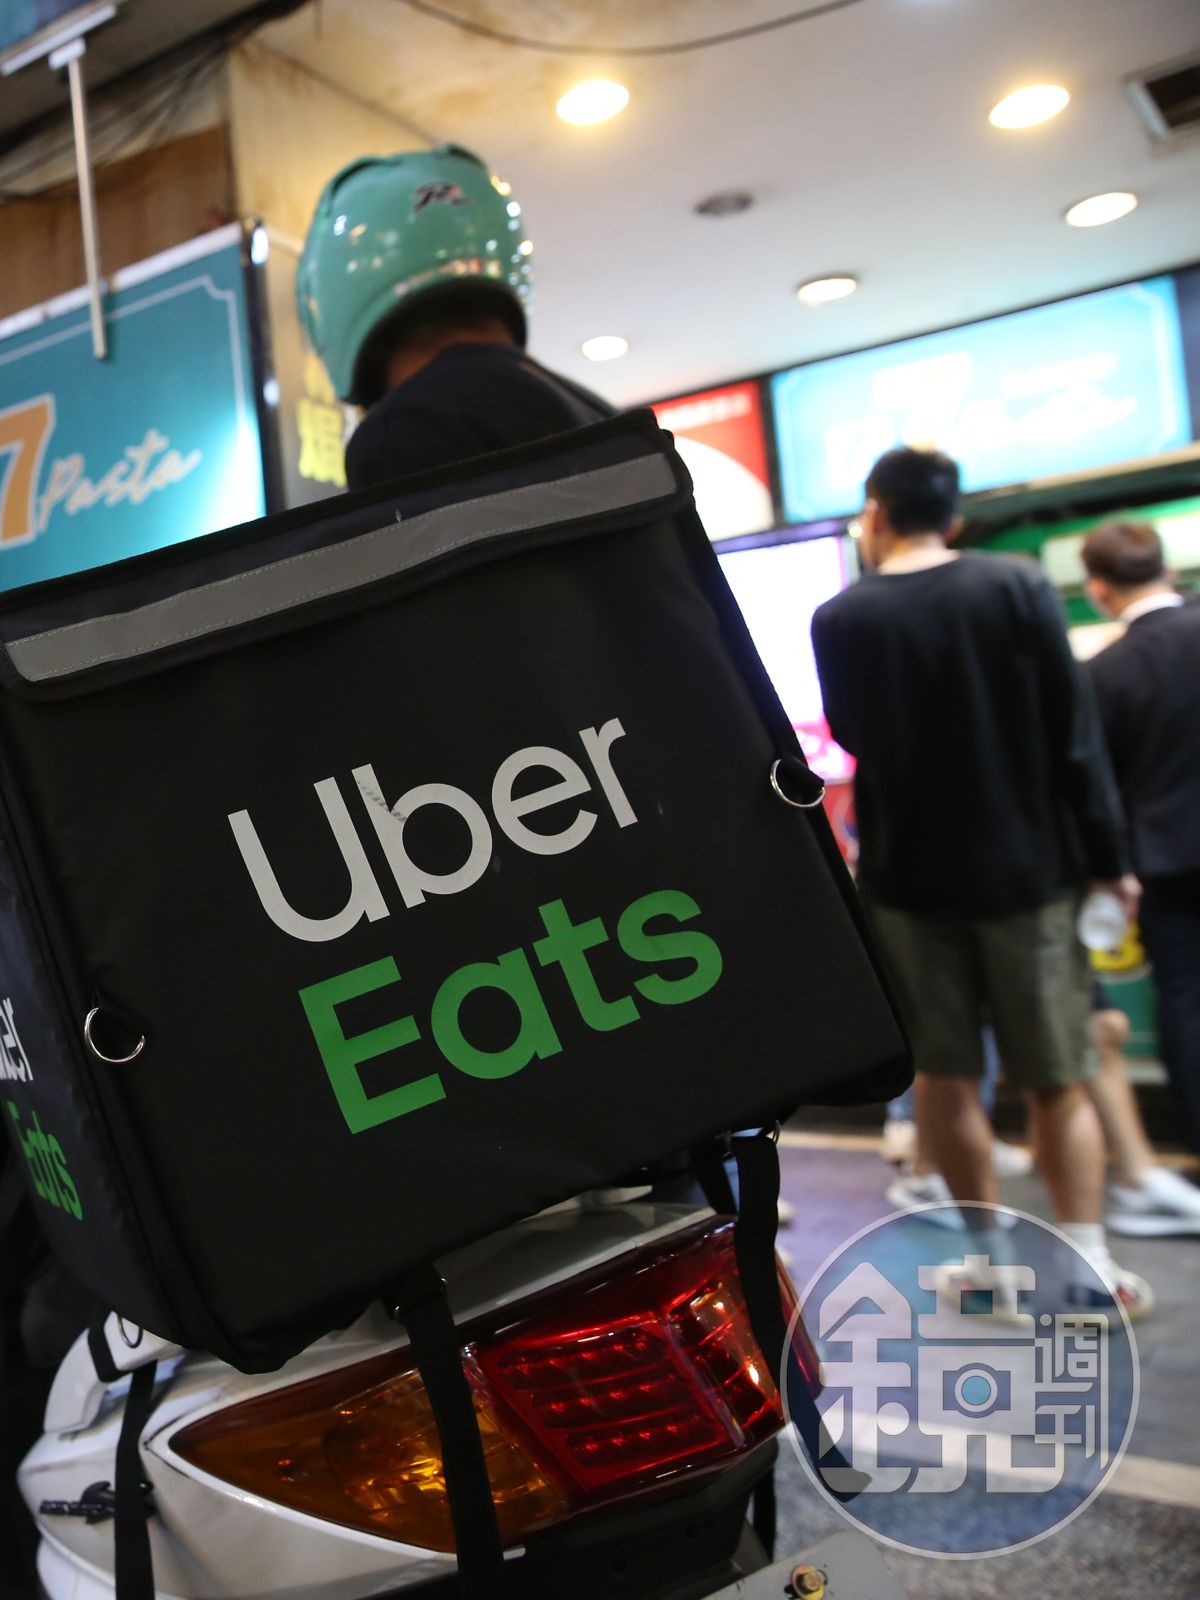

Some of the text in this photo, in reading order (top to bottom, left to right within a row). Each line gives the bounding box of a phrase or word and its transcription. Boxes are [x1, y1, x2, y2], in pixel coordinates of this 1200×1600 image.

[36, 427, 203, 535] Pasta
[227, 716, 639, 943] Uber
[298, 888, 724, 1135] Eats
